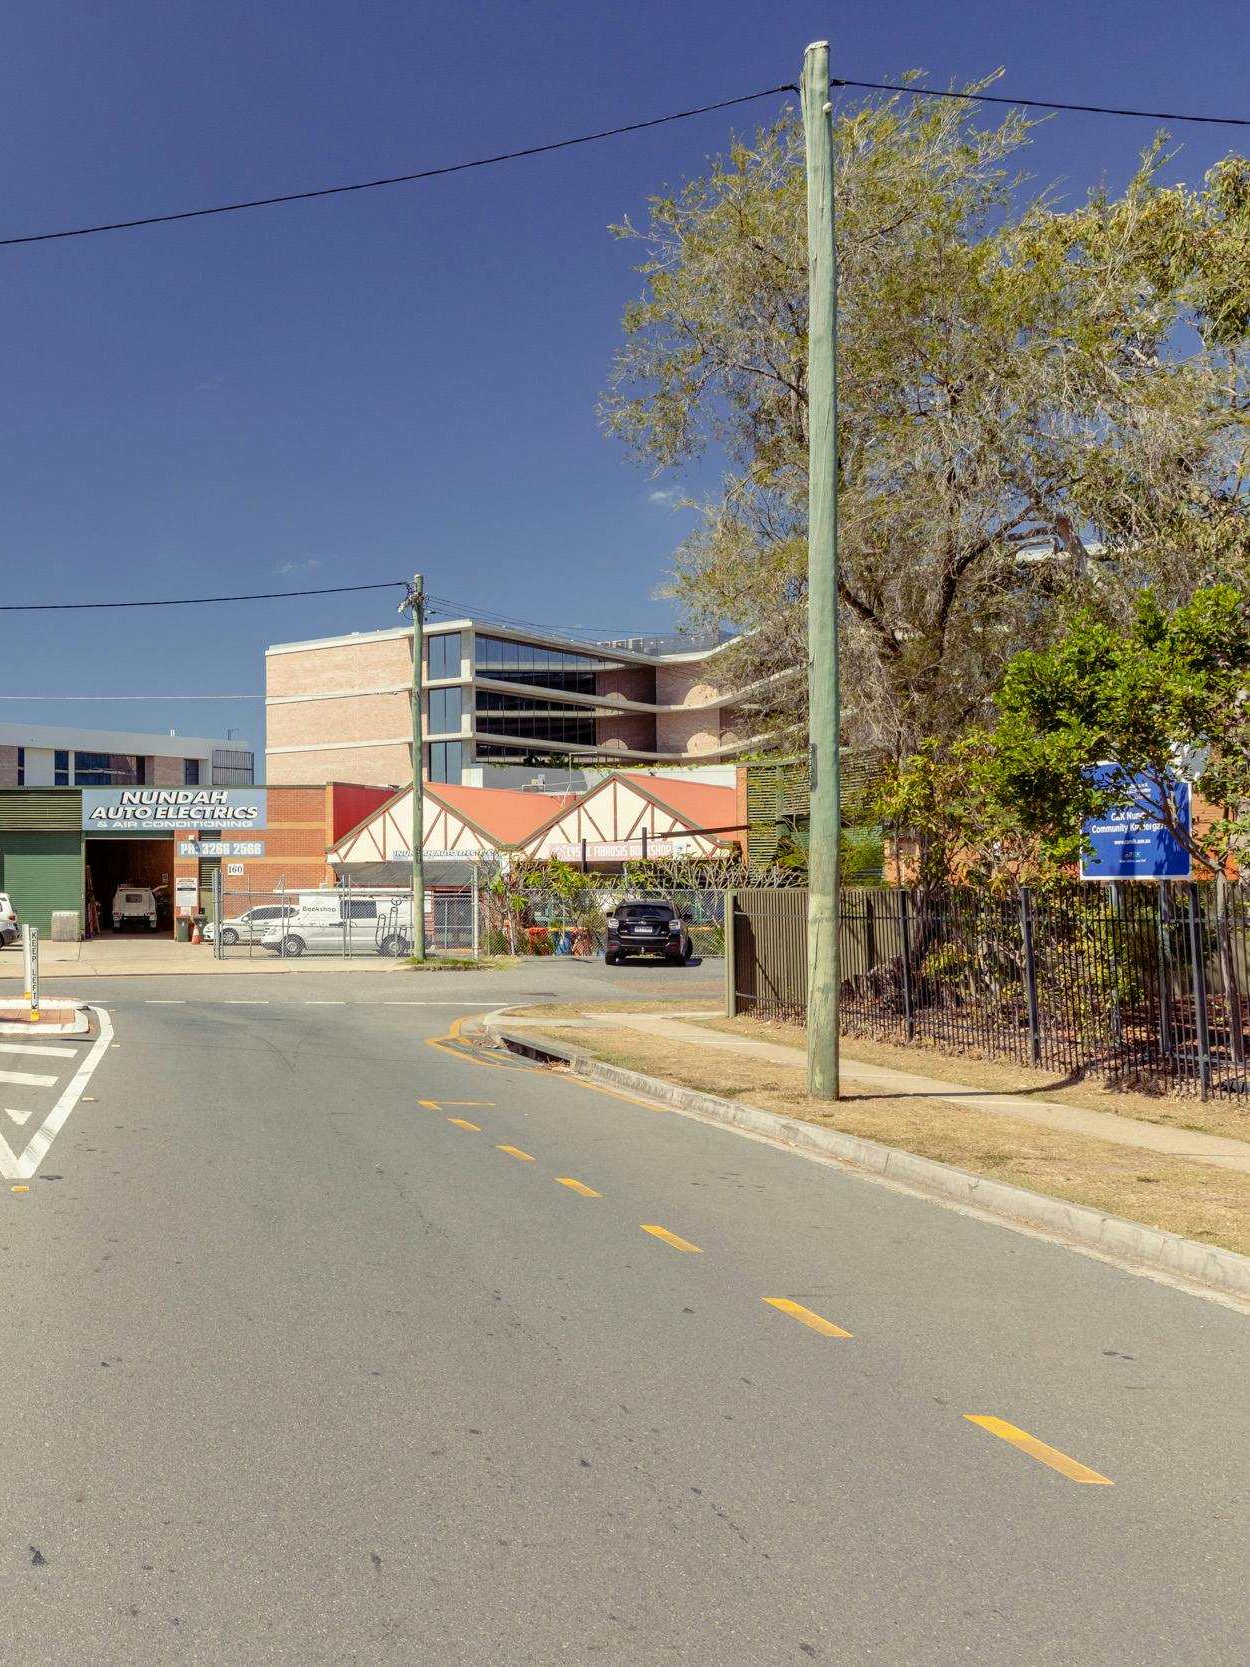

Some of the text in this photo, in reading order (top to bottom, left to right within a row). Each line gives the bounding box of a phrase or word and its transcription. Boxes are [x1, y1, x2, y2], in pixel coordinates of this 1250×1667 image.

[121, 791, 228, 805] NUNDAH
[89, 806, 258, 820] AUTO ELECTRICS
[1092, 824, 1128, 833] Community
[201, 843, 230, 855] 3266
[233, 843, 262, 855] 2566
[566, 845, 593, 857] CYSIC
[594, 845, 627, 857] FIBROSIS
[228, 864, 243, 873] 160
